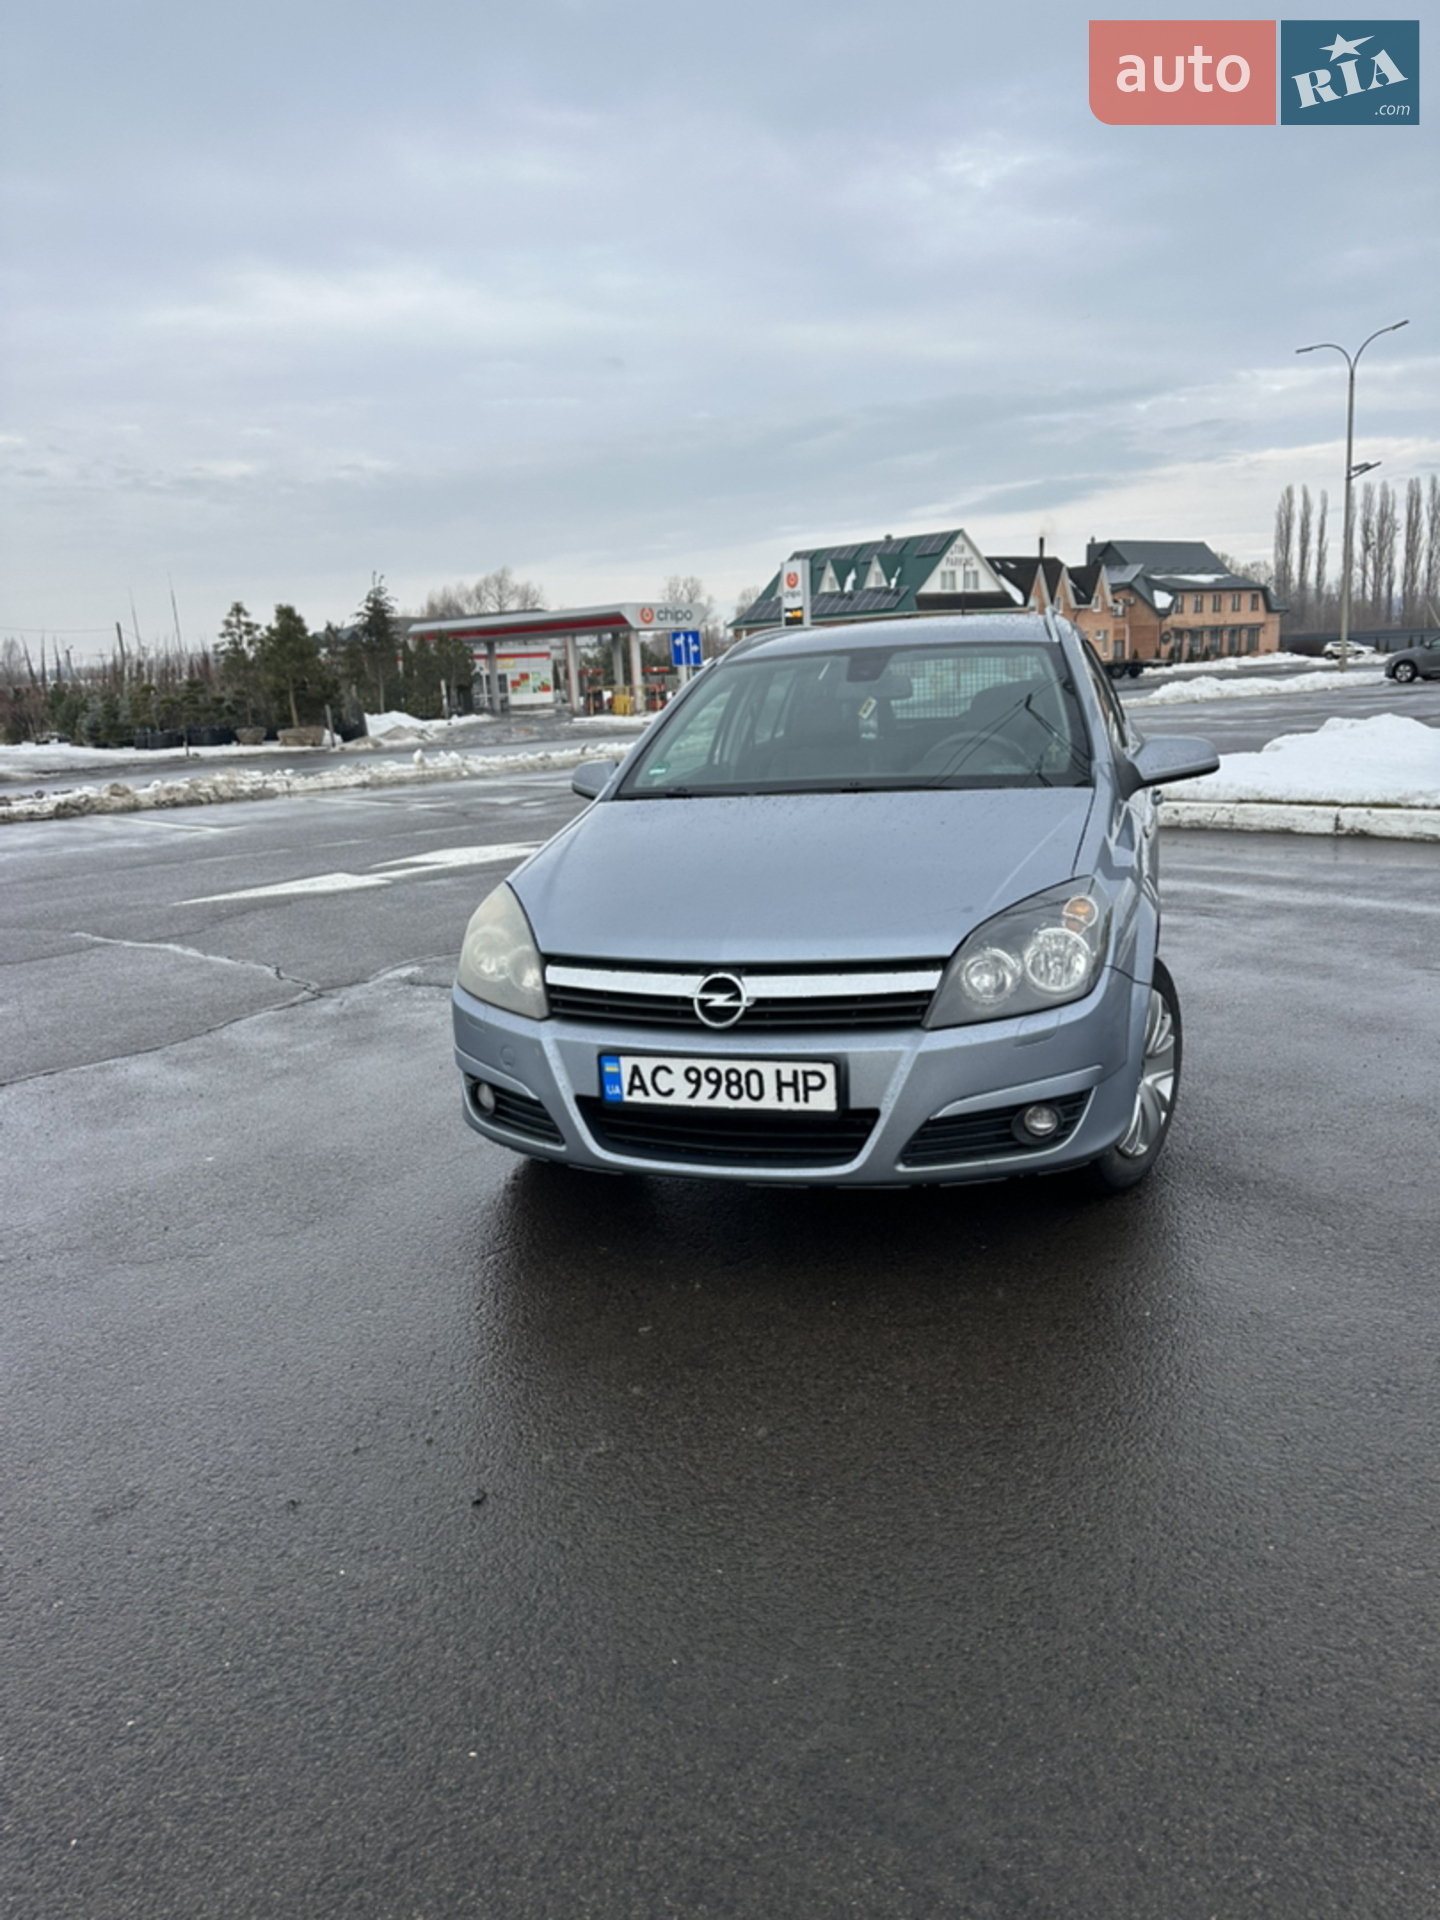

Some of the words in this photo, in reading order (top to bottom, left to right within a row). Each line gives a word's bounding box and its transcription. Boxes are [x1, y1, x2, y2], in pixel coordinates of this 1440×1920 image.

[656, 606, 693, 625] chipo
[605, 1084, 621, 1096] UA
[626, 1064, 675, 1097] AC
[683, 1066, 765, 1101] 9980
[775, 1068, 827, 1104] HP
